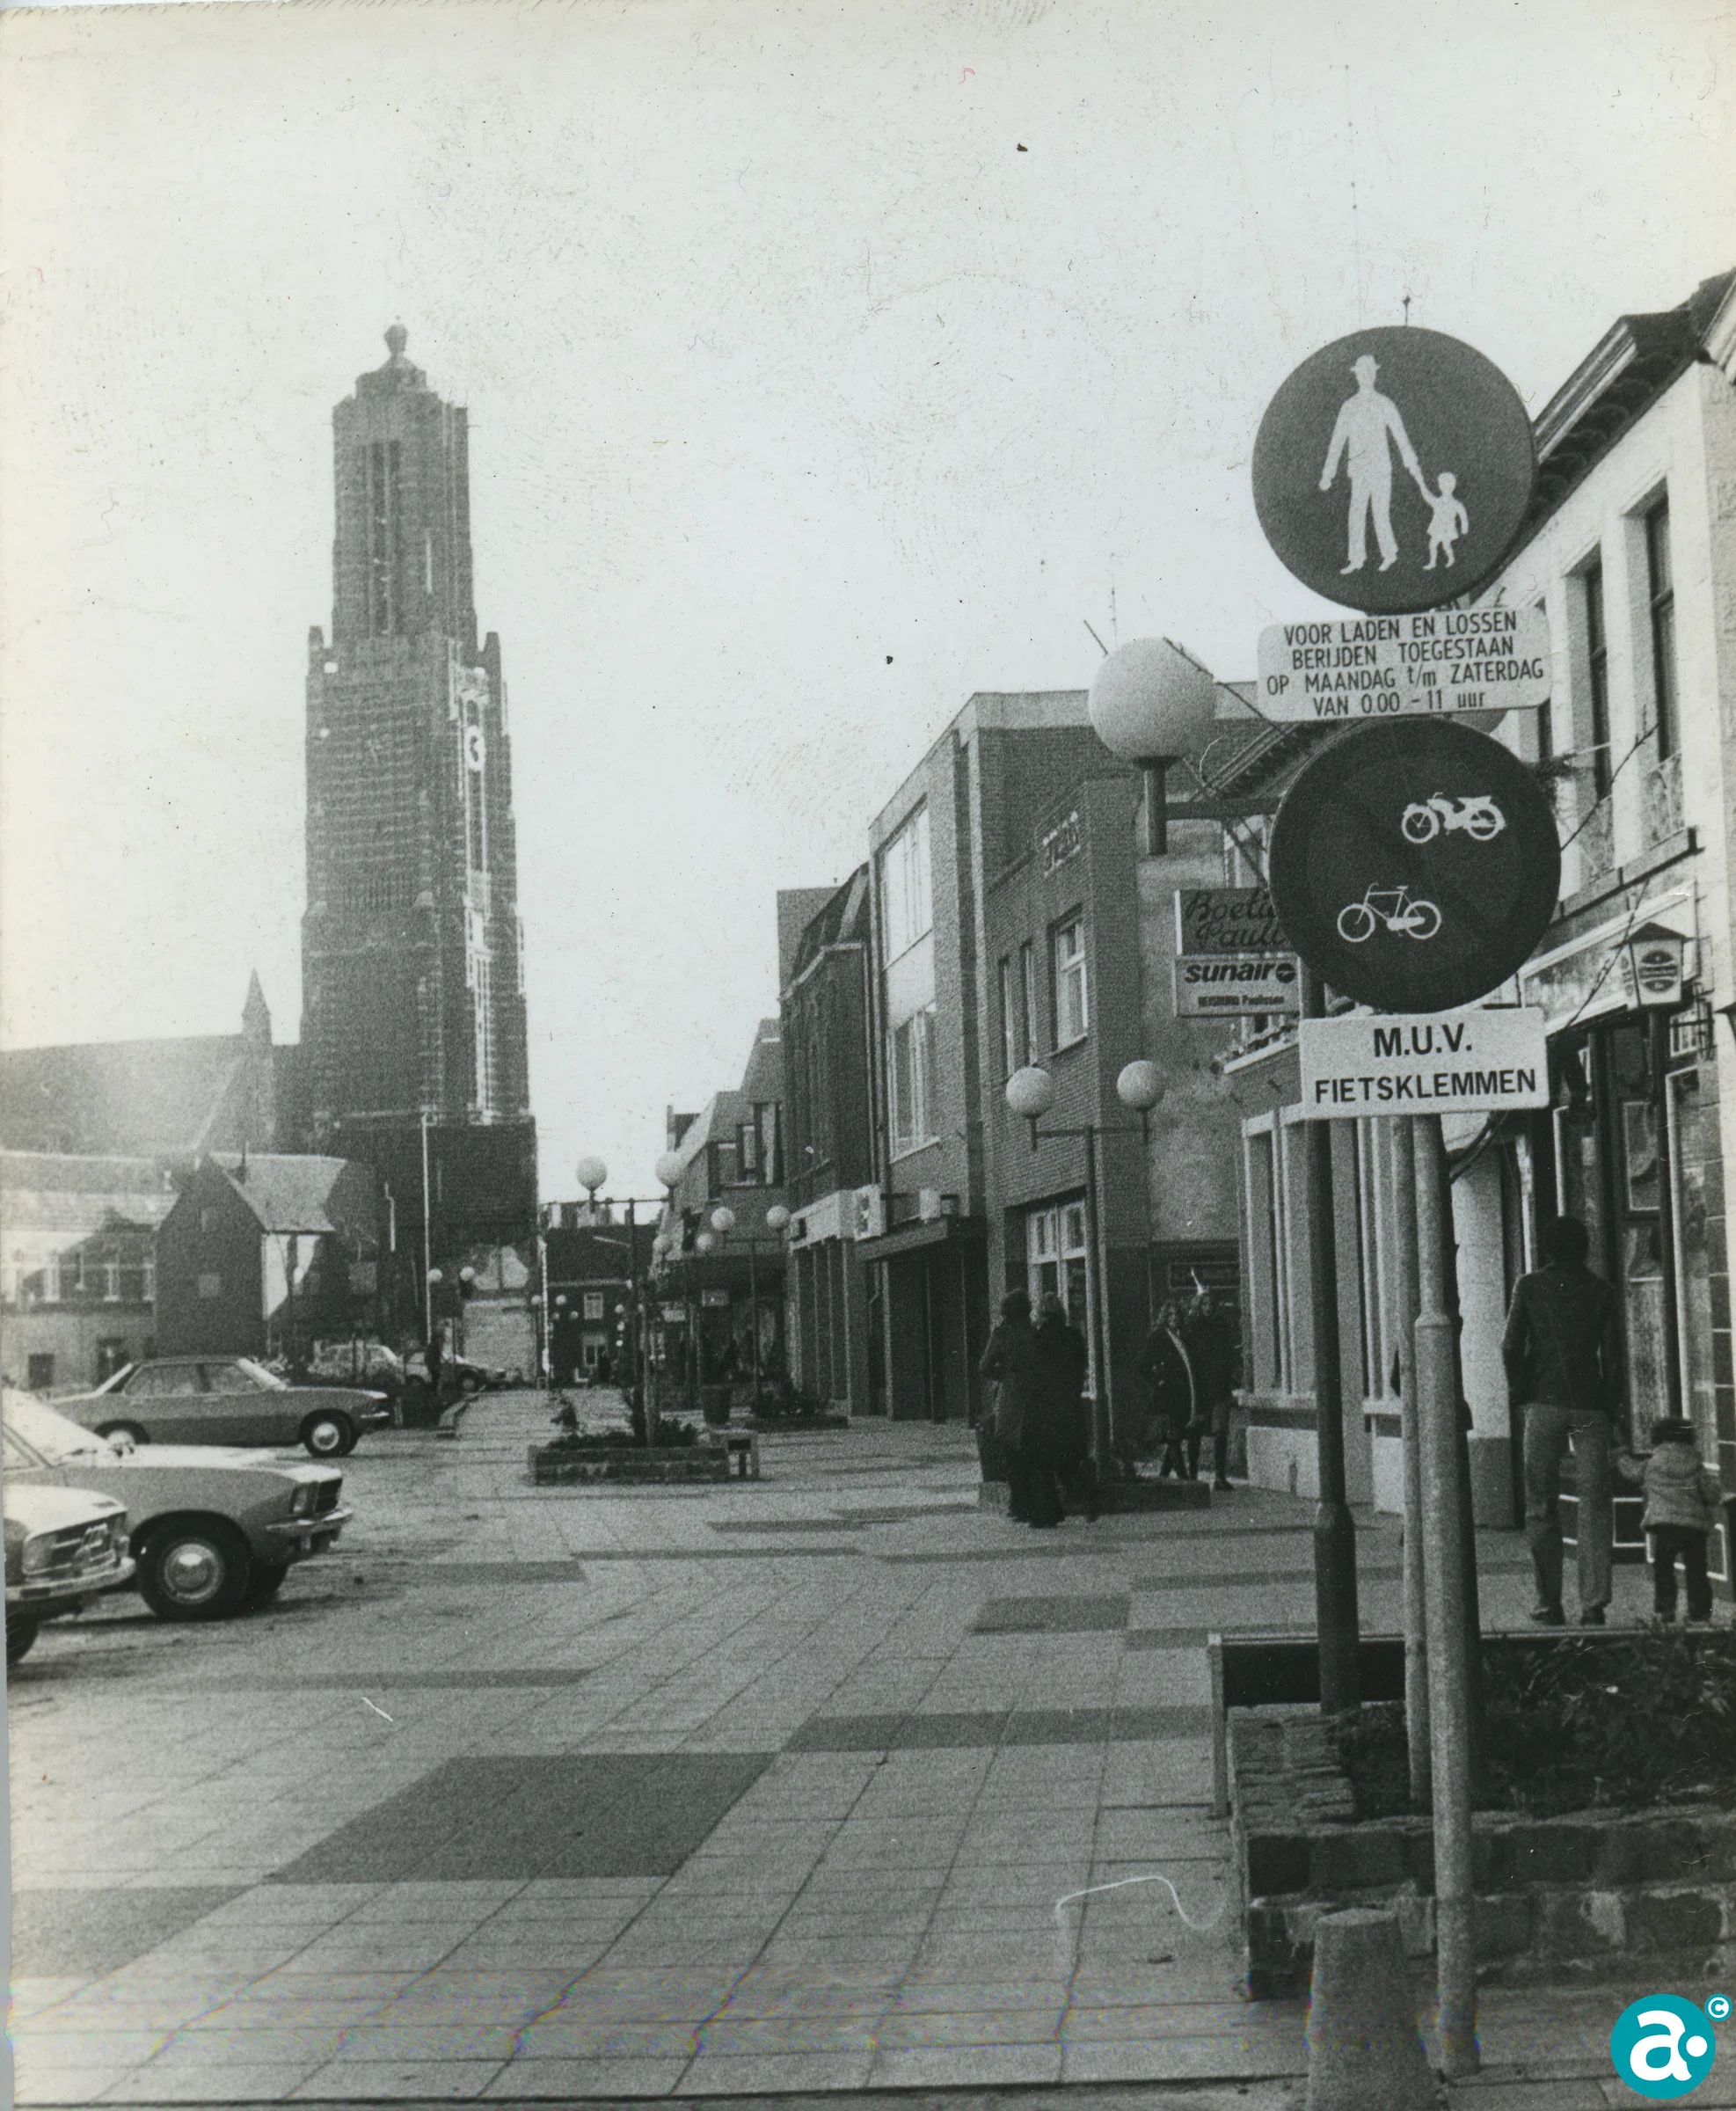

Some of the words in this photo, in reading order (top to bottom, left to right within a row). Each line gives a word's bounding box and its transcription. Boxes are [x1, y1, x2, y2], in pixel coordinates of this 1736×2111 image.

[1283, 624, 1331, 646] VOOR
[1341, 619, 1400, 643] LADEN
[1412, 617, 1435, 637] EN
[1447, 611, 1517, 635] LOSSEN
[1292, 646, 1377, 670] BERIJDEN
[1398, 636, 1514, 662] TOEGESTAAN
[1267, 675, 1290, 695] OP
[1305, 668, 1397, 693] MAANDAG
[1407, 664, 1437, 687] t/m
[1451, 658, 1544, 684] ZATERDAG
[1312, 695, 1349, 717] VAN
[1427, 690, 1443, 710] 11
[1457, 691, 1485, 708] uur
[1185, 963, 1275, 983] sunair
[1374, 1023, 1472, 1057] M.U.V.
[1316, 1069, 1536, 1103] FIETSKLEMMEN
